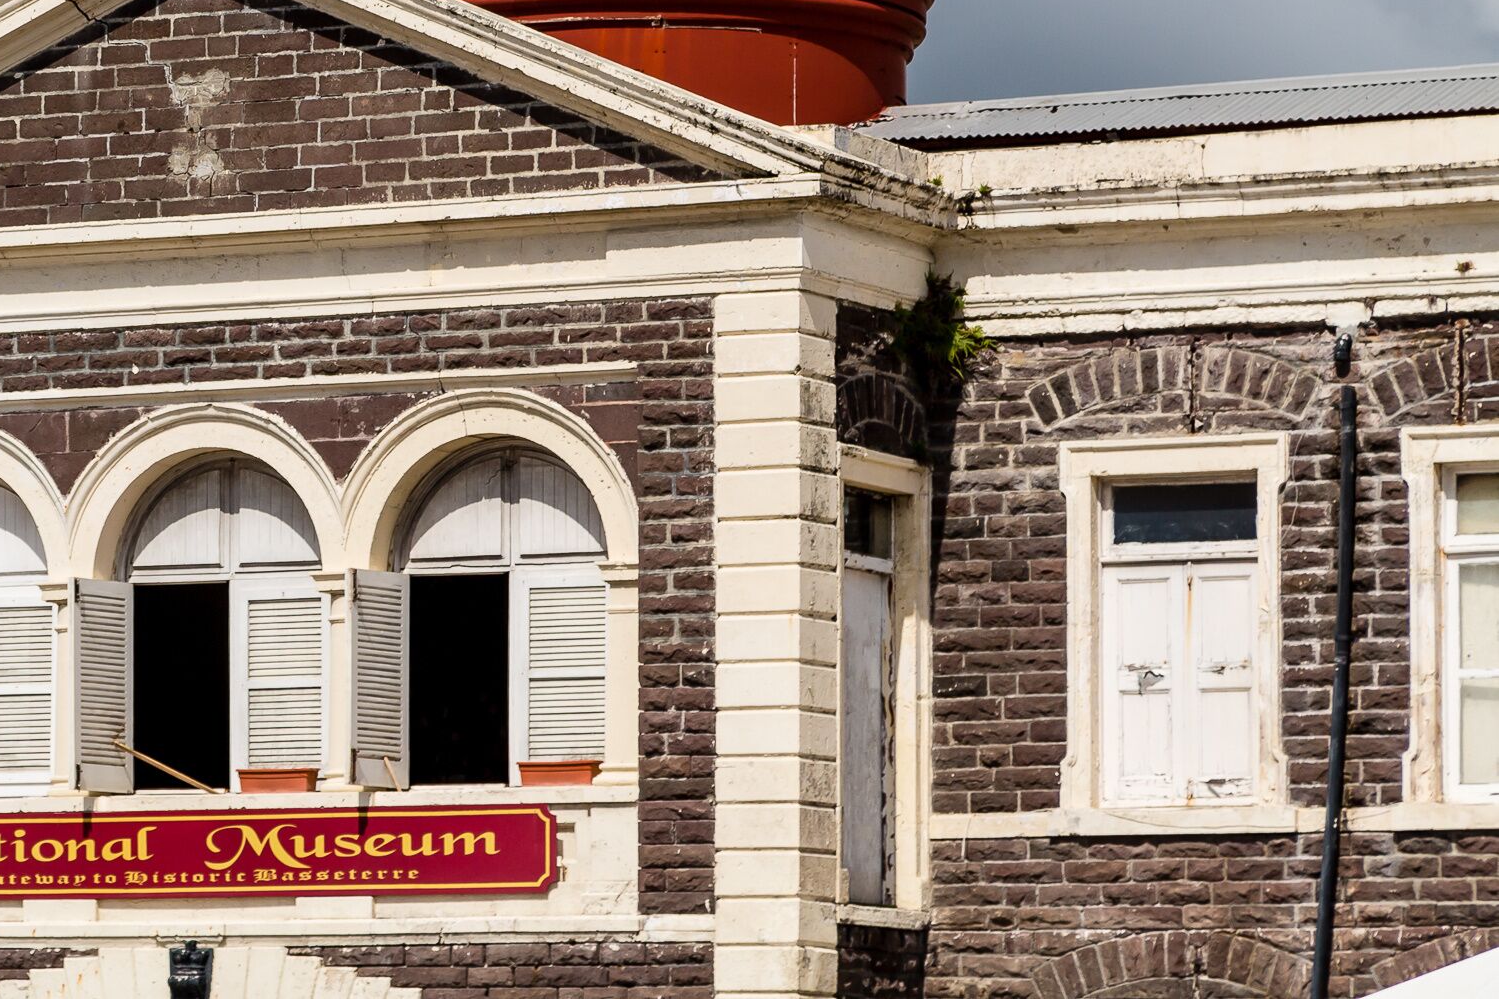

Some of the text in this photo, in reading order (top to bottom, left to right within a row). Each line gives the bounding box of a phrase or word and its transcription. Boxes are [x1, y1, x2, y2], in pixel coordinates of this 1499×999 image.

[204, 824, 501, 869] Museum
[93, 872, 117, 884] to
[124, 870, 247, 886] Historic
[253, 868, 420, 883] Basseterre
